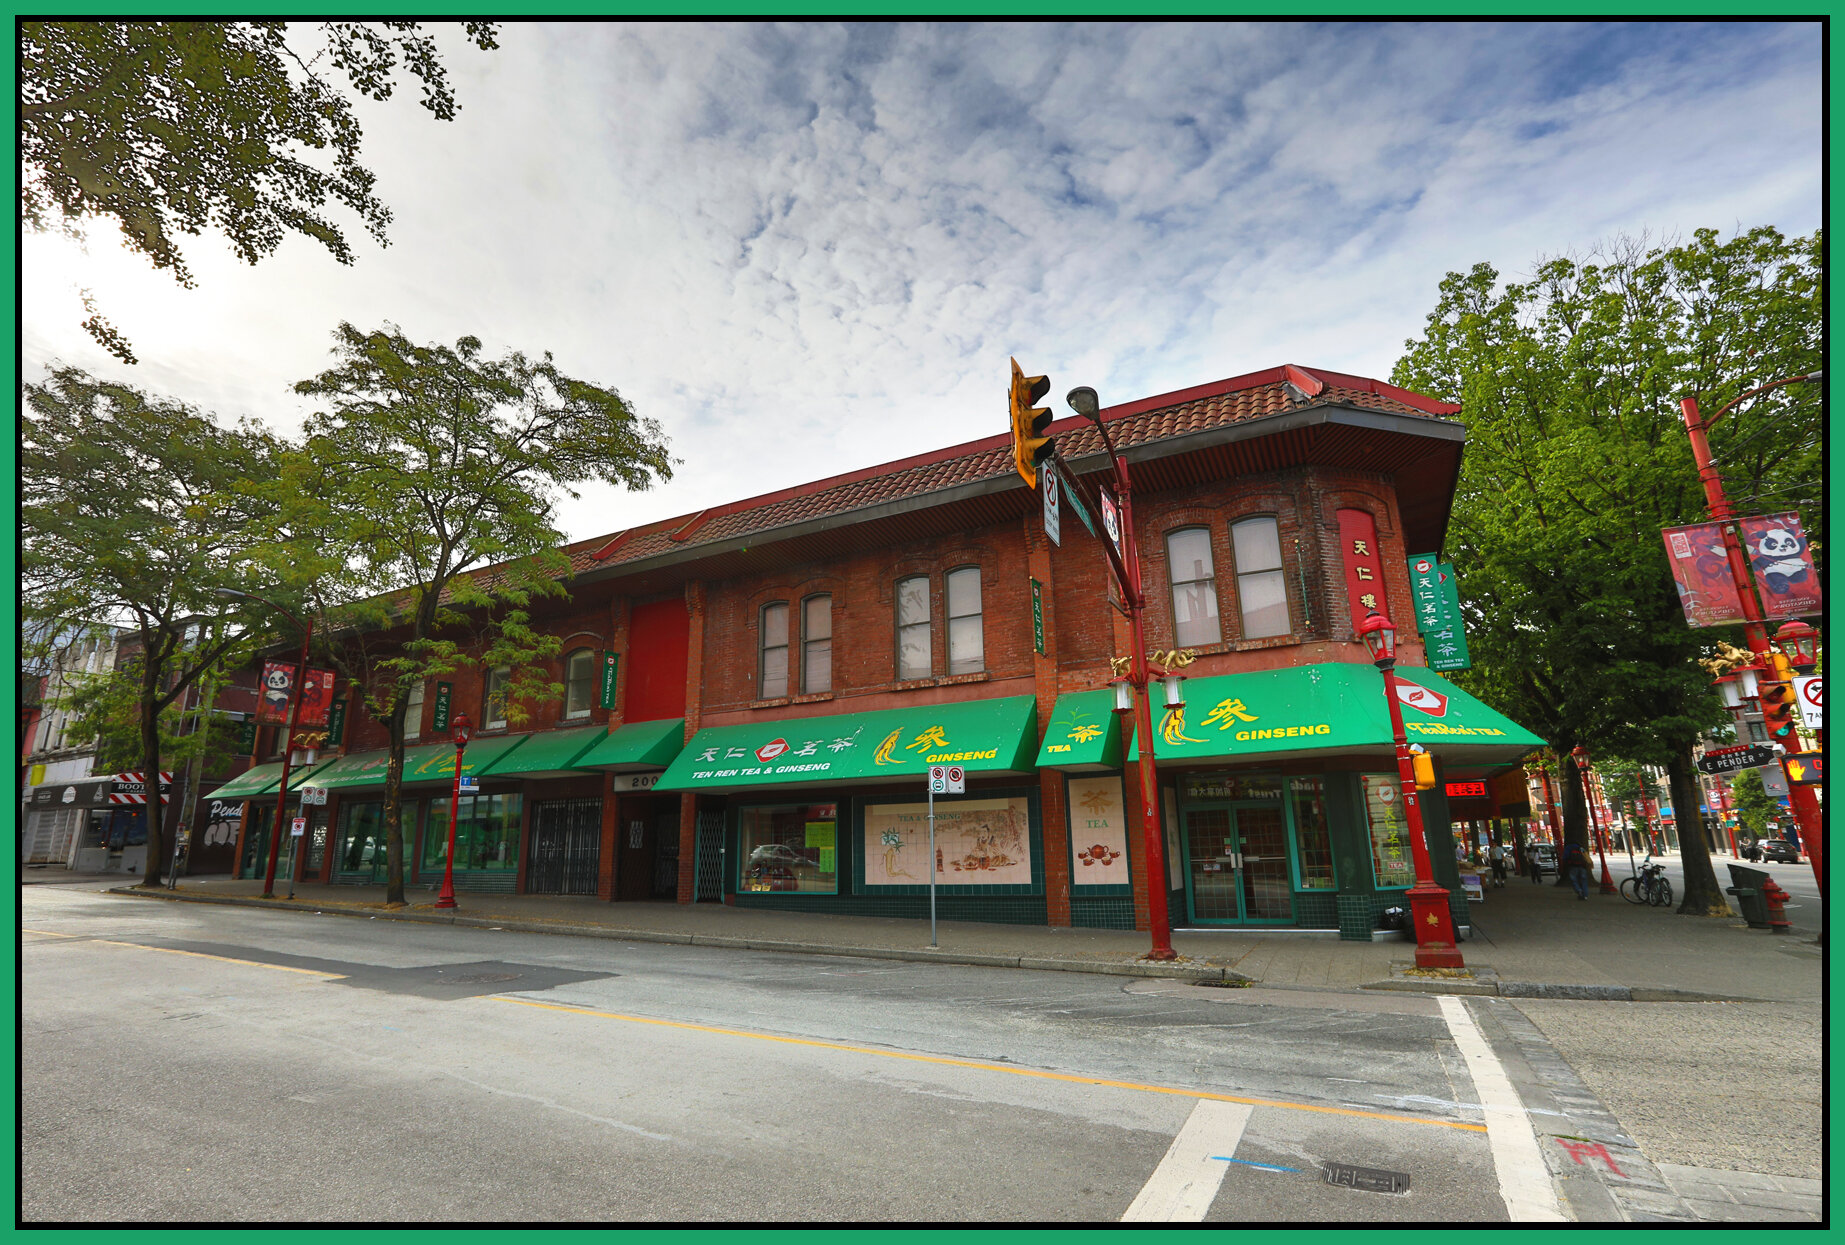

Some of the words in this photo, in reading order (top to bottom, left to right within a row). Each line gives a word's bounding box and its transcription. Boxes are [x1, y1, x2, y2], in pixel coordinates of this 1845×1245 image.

[1418, 577, 1439, 628] 天仁茗茶
[1806, 712, 1813, 722] 7
[1235, 724, 1331, 741] GINSENG
[1047, 744, 1071, 752] TEA
[925, 749, 997, 763] GINSENG
[1706, 762, 1713, 770] E
[1717, 755, 1756, 768] PENDER
[692, 771, 713, 779] TEN
[714, 769, 738, 778] REN
[740, 768, 760, 776] TEA
[763, 766, 773, 775] &
[775, 762, 831, 774] GINSENG
[631, 776, 659, 787] 200
[1087, 819, 1109, 829] TEA
